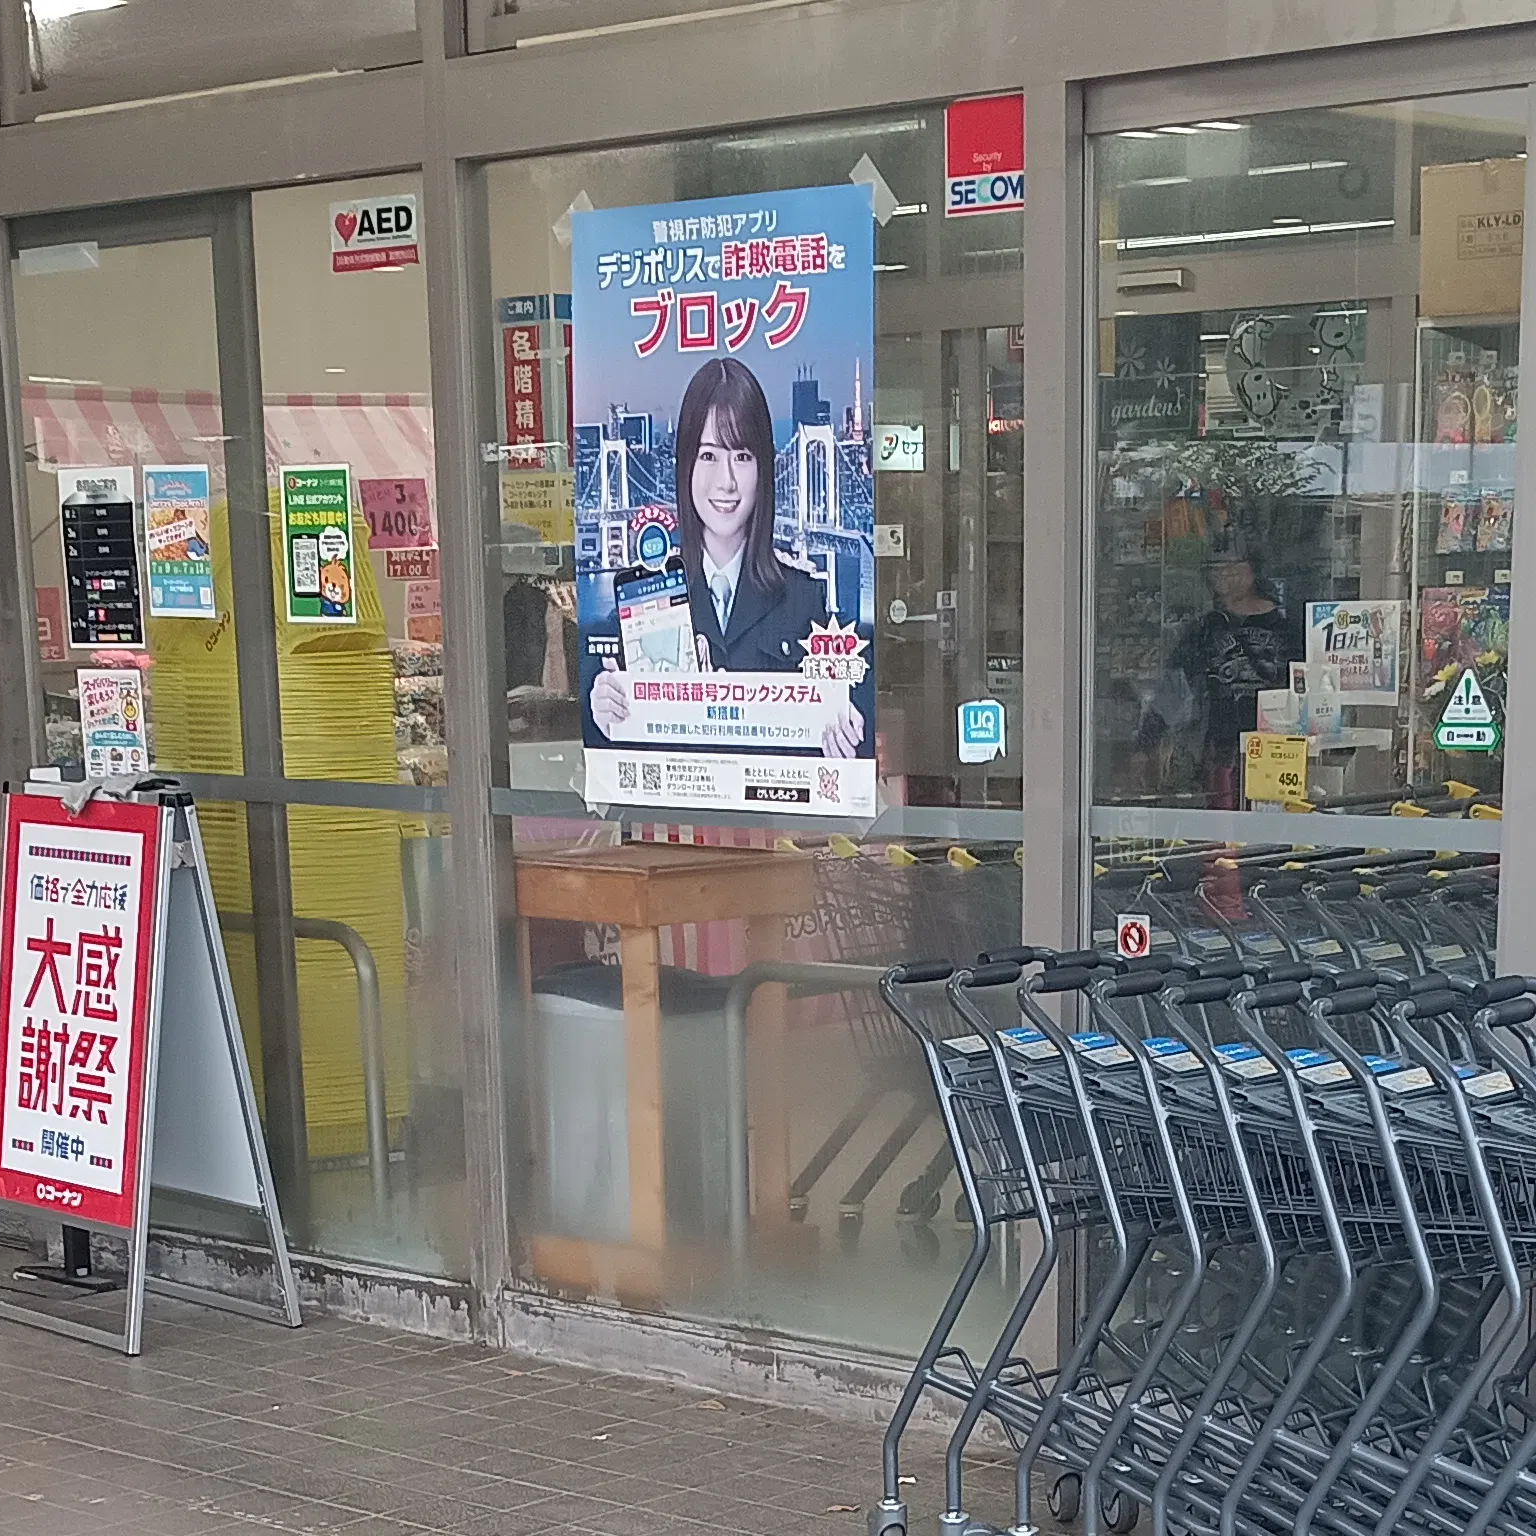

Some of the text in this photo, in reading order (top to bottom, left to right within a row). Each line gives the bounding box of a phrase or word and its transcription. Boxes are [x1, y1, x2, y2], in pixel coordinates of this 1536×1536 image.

[972, 151, 1003, 164] Security
[982, 162, 993, 172] by
[357, 205, 413, 237] AED
[652, 209, 777, 244] 警視庁防犯アプリ
[597, 231, 846, 290] デジポリスで詐欺電話を
[630, 279, 810, 360] ブロック
[394, 483, 407, 505] 3
[810, 634, 858, 657] STOP
[804, 657, 866, 681] 詐欺被害
[633, 681, 823, 704] 国際電話番号ブロックシステム
[969, 710, 995, 729] UQ
[1278, 772, 1300, 787] 450
[756, 788, 799, 801] けいしちょう
[30, 873, 129, 912] 価格で全力応援
[22, 916, 124, 1023] 大感
[18, 1016, 119, 1125] 謝祭
[40, 1128, 85, 1162] 開催中
[47, 1184, 84, 1207] コーナン
